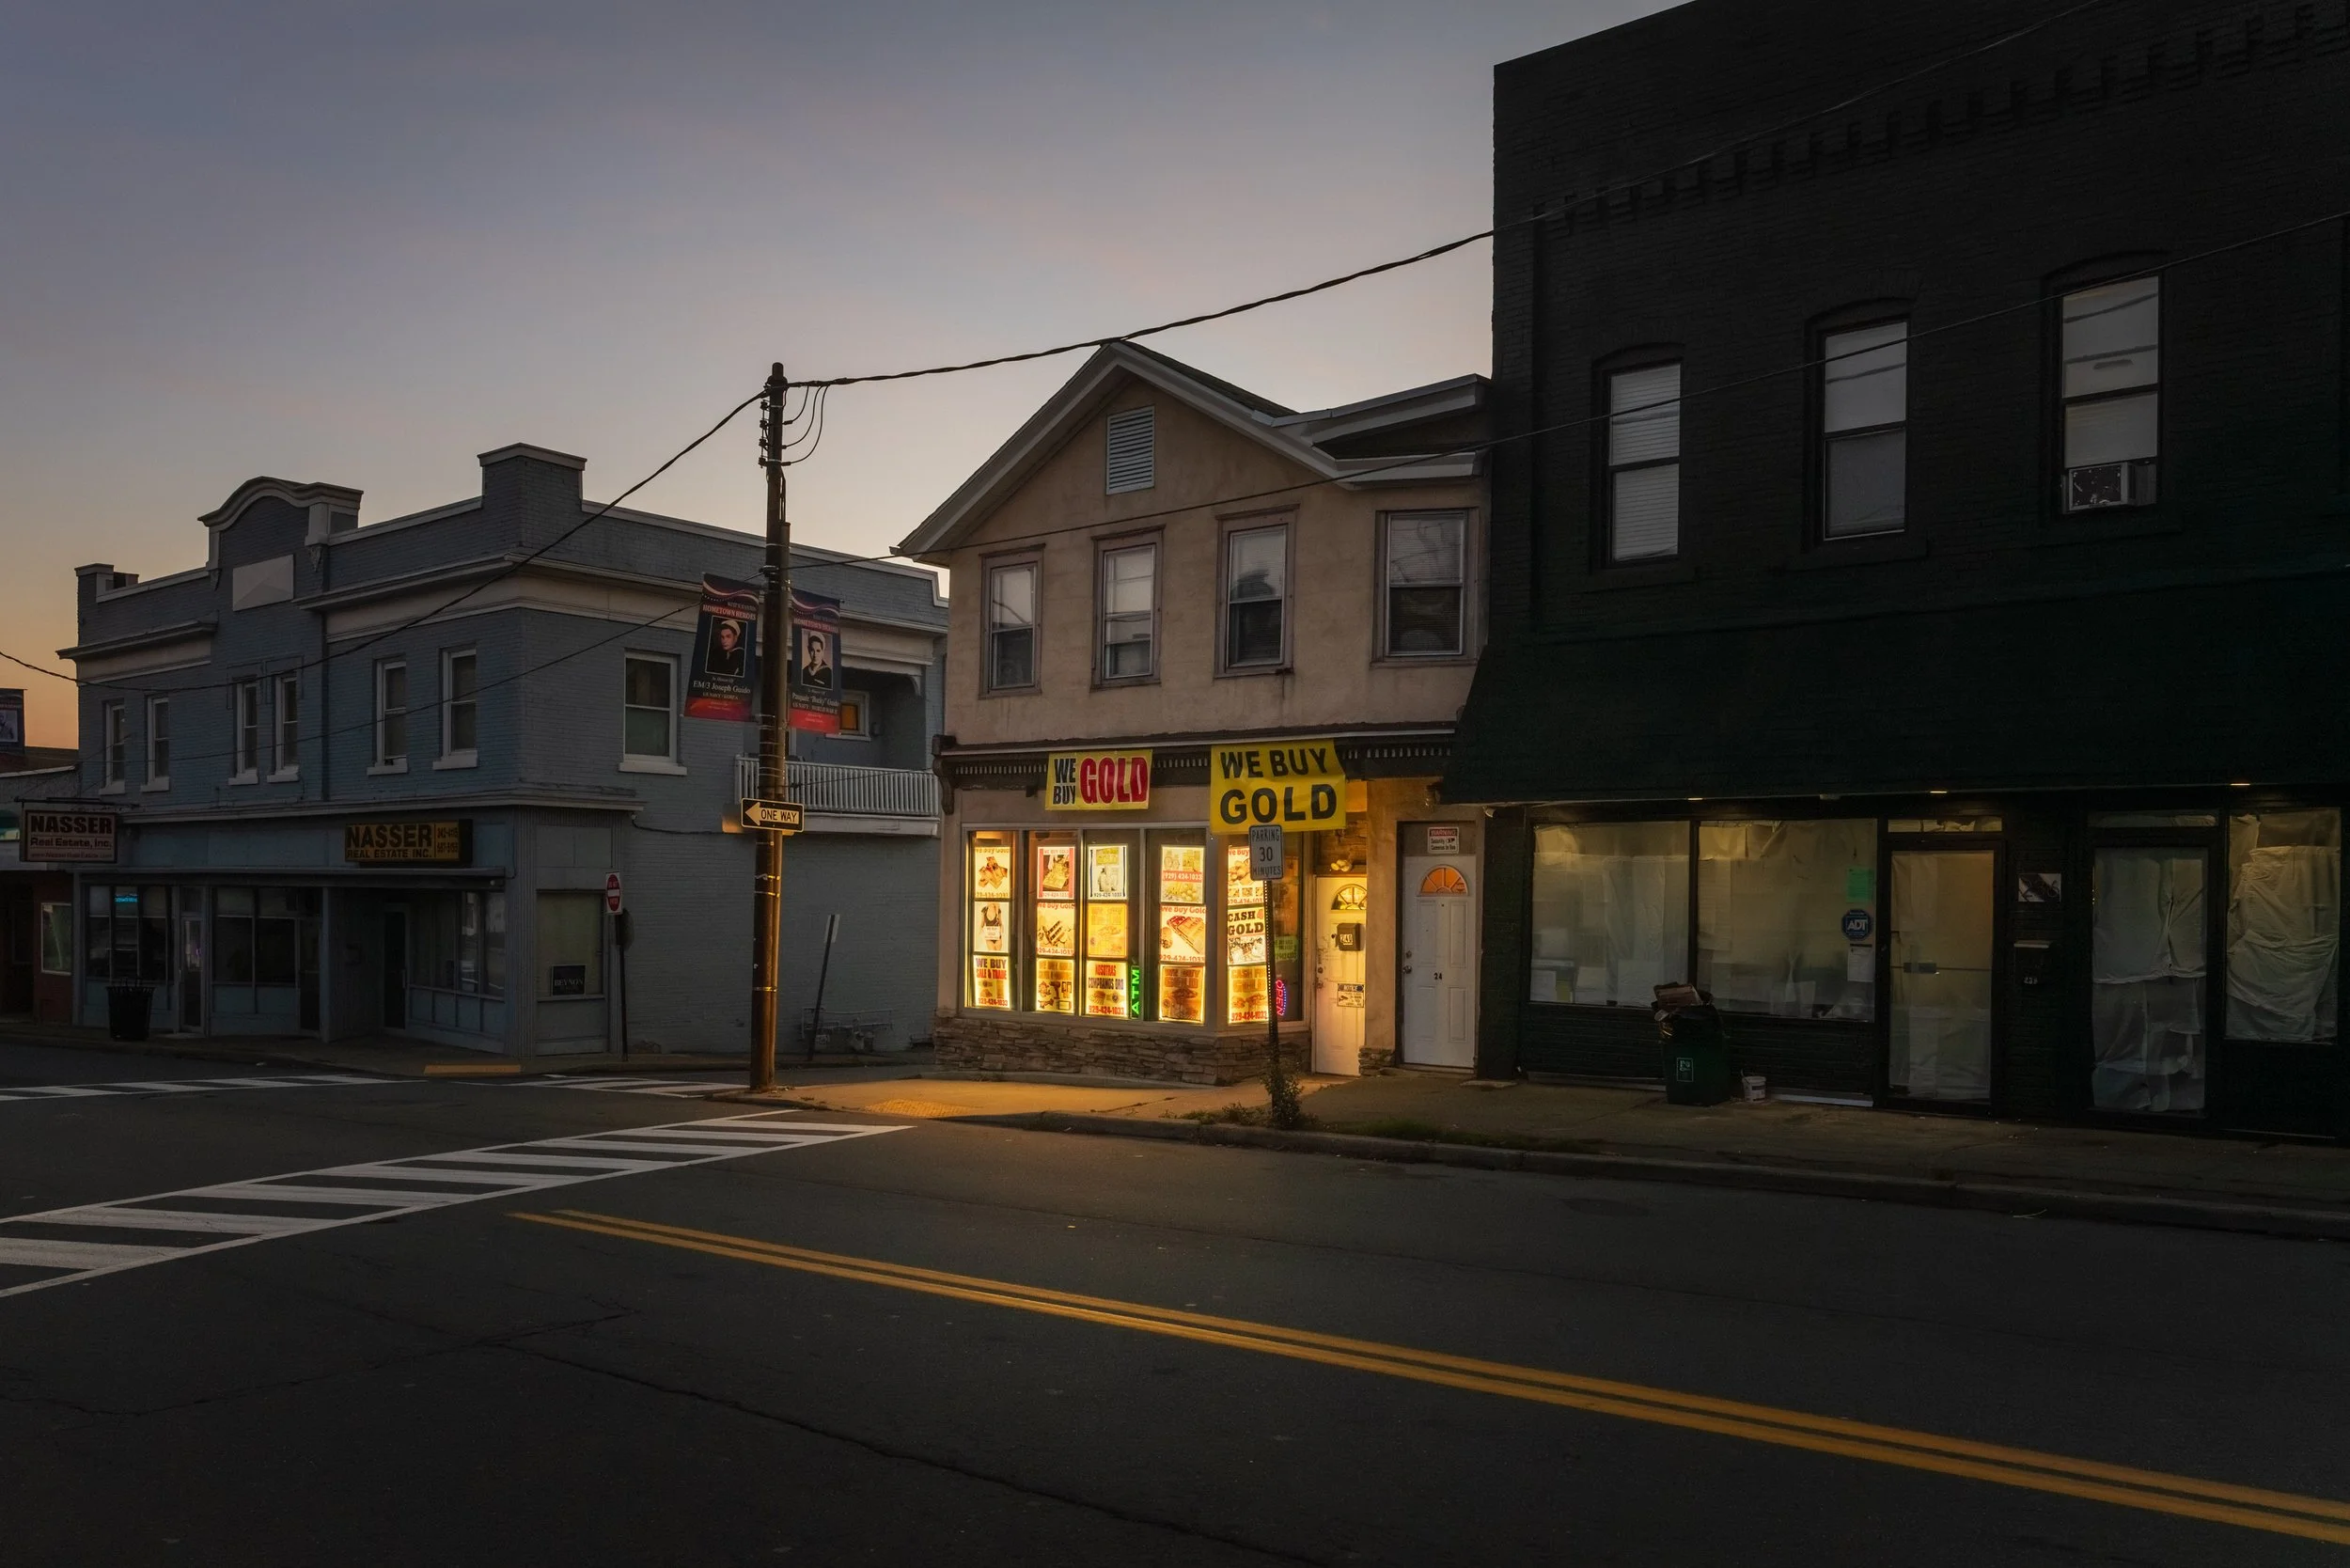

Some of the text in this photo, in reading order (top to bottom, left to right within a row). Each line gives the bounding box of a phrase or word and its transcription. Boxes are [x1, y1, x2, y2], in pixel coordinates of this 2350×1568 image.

[712, 682, 732, 693] Joseph
[1055, 758, 1076, 783] WE
[1220, 748, 1327, 779] WE BUY
[1079, 757, 1148, 804] GOLD
[1053, 786, 1075, 805] BUY
[1220, 784, 1337, 824] GOLD
[760, 808, 797, 823] ONE WAY
[30, 815, 112, 835] NASSER
[347, 824, 432, 848] NASSER
[1251, 828, 1280, 841] PARKING
[30, 837, 54, 847] Real
[55, 838, 93, 849] Estate,
[347, 848, 433, 858] REAL ESTATE INC.
[1259, 846, 1274, 862] 30
[1252, 865, 1281, 877] MINUTES
[1228, 911, 1256, 922] CASH
[1228, 922, 1265, 935] GOLD
[1847, 918, 1867, 931] ADT
[976, 958, 1007, 969] WE BUY
[554, 978, 584, 987] BEYNON
[1276, 980, 1284, 1015] OPEN
